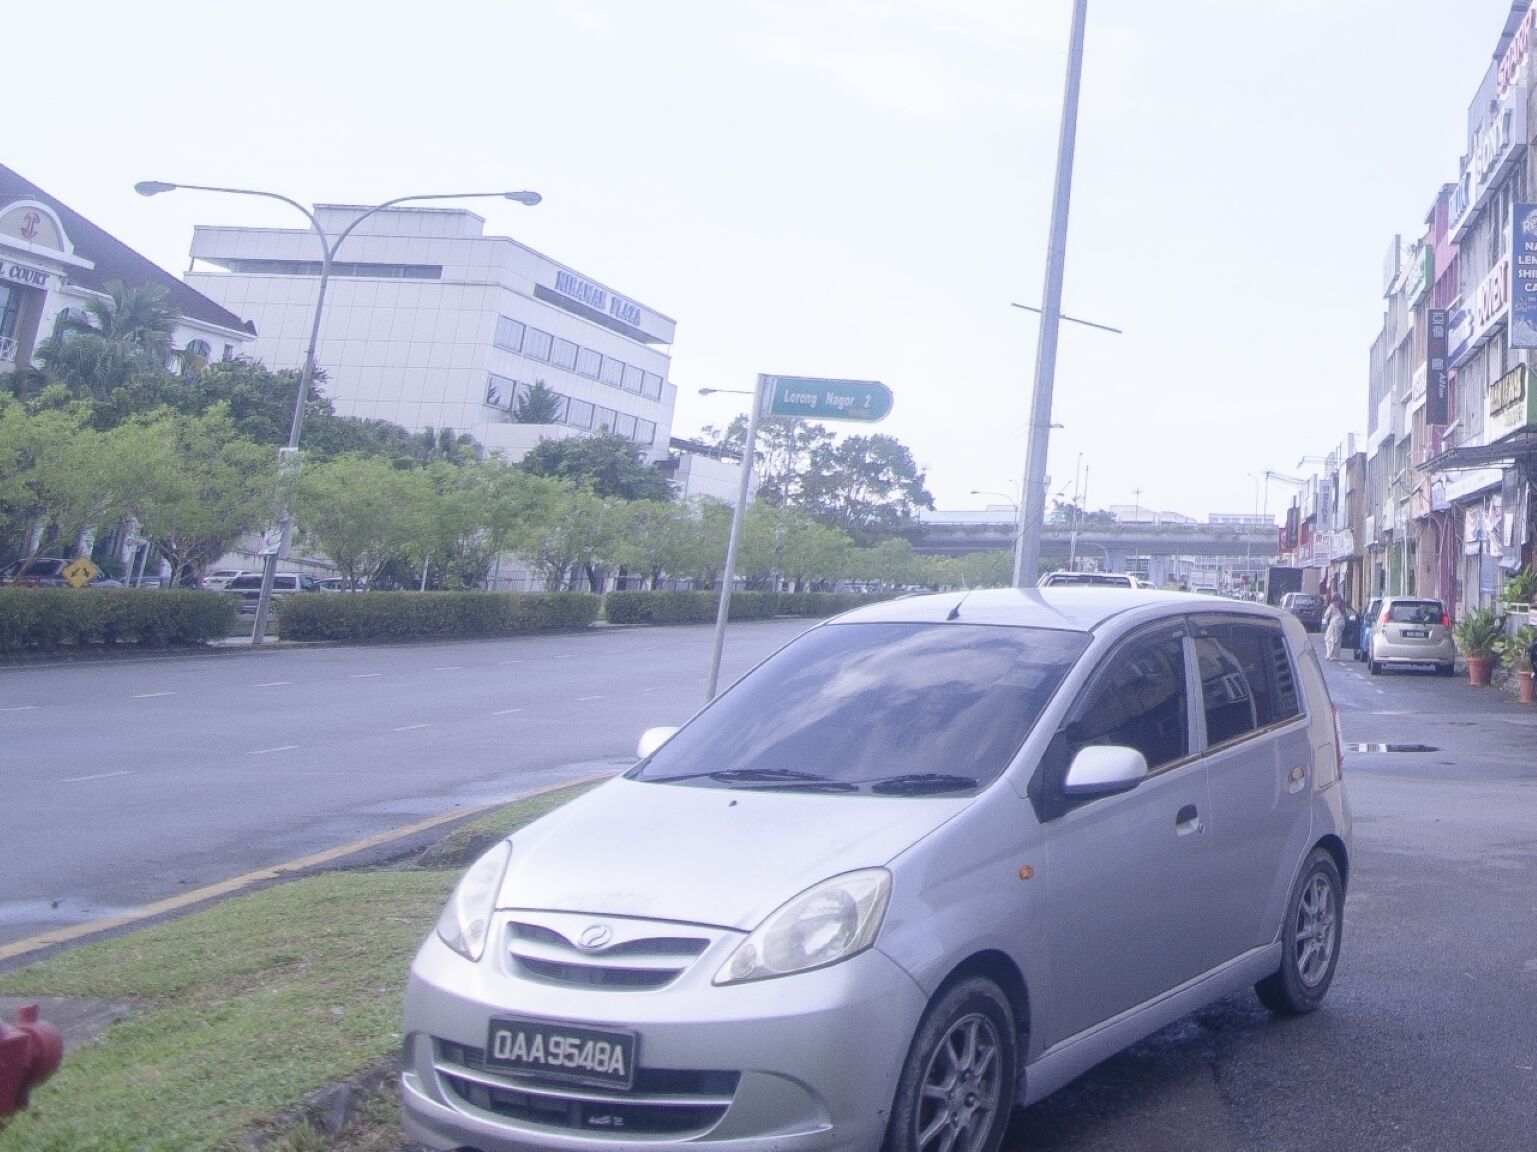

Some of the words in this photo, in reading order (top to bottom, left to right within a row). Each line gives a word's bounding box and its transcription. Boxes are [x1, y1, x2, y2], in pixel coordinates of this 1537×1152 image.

[9, 264, 50, 286] COURT
[783, 389, 818, 408] Lorong
[864, 394, 872, 409] 2
